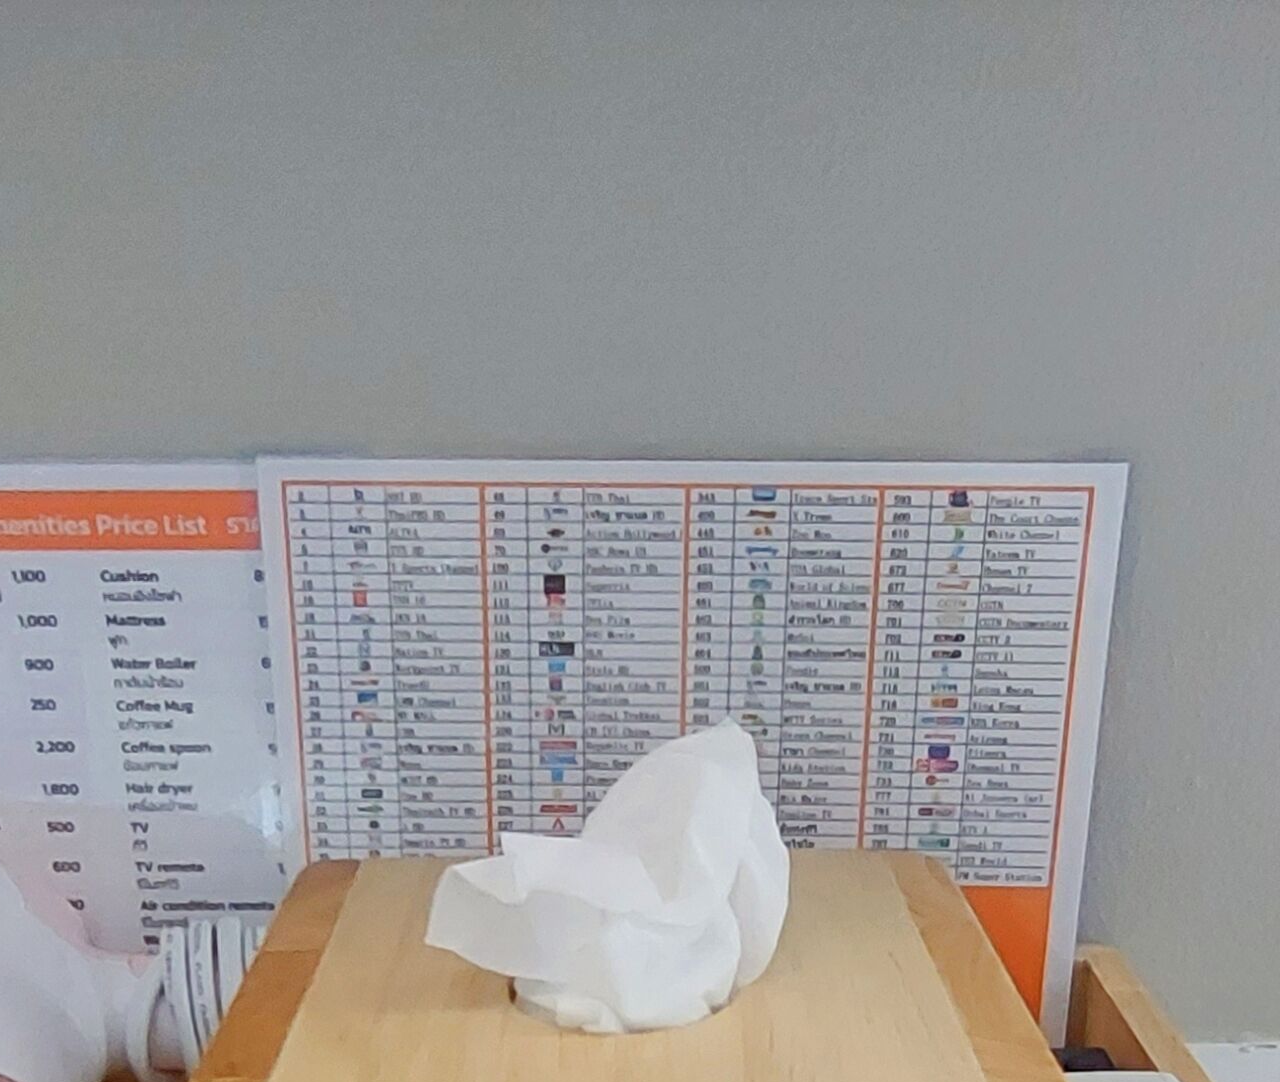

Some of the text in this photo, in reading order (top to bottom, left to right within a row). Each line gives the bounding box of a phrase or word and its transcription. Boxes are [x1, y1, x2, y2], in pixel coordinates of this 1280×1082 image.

[97, 514, 157, 536] Price
[164, 513, 207, 536] List
[100, 570, 159, 583] Cushion
[19, 615, 57, 629] 1,000
[106, 615, 165, 628] Mattress
[25, 659, 54, 672] 900
[111, 658, 196, 671] Water Boiler
[31, 700, 56, 711] 250
[117, 700, 194, 715] Coffee Mug
[36, 741, 75, 755] 2,200
[122, 741, 212, 757] Coffee spoon
[125, 782, 193, 798] Hair dryer
[47, 822, 75, 833] 500
[130, 822, 149, 834] TV
[52, 861, 81, 873] 600
[135, 861, 205, 873] TV remote
[140, 899, 275, 912] Air condition remote
